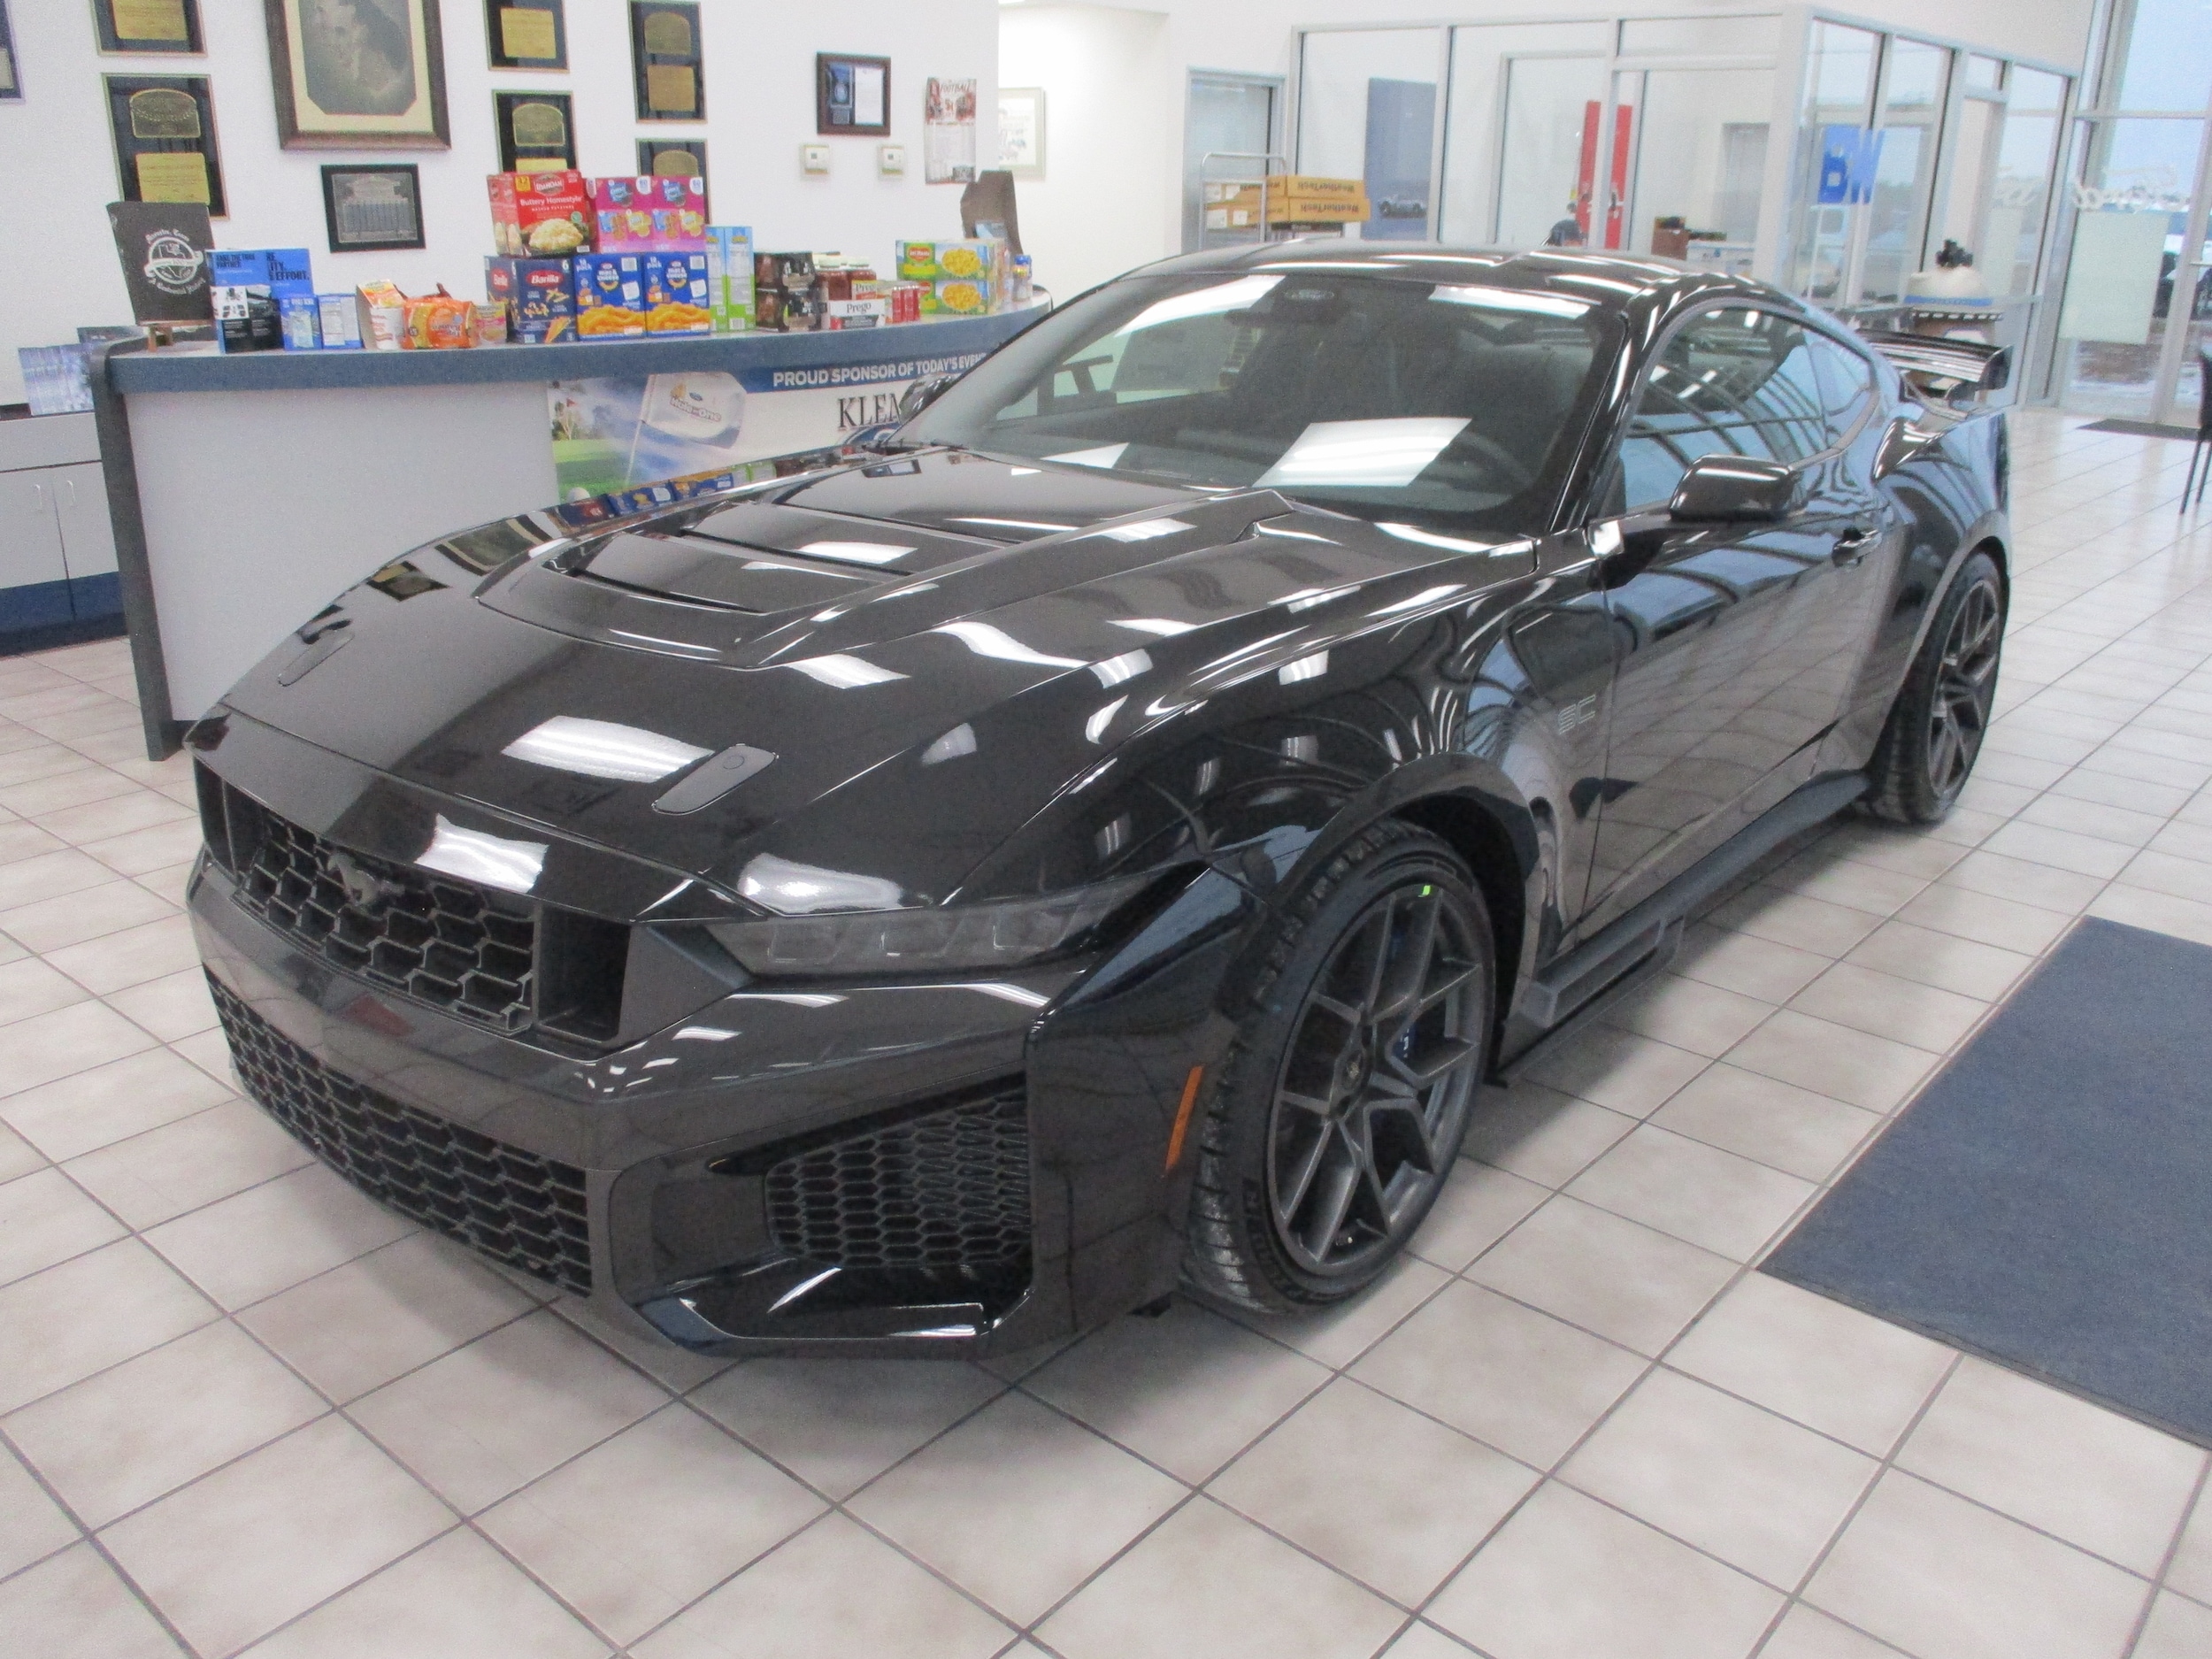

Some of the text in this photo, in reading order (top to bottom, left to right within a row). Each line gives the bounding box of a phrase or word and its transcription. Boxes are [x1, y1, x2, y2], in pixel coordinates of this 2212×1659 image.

[547, 196, 582, 204] Homestyle
[563, 260, 568, 271] 6
[531, 274, 559, 284] Barilla
[847, 303, 872, 313] Prego
[773, 371, 829, 387] PROUD
[831, 365, 896, 383] SPONSOR
[898, 362, 915, 377] OF
[916, 357, 958, 374] TODAY'S
